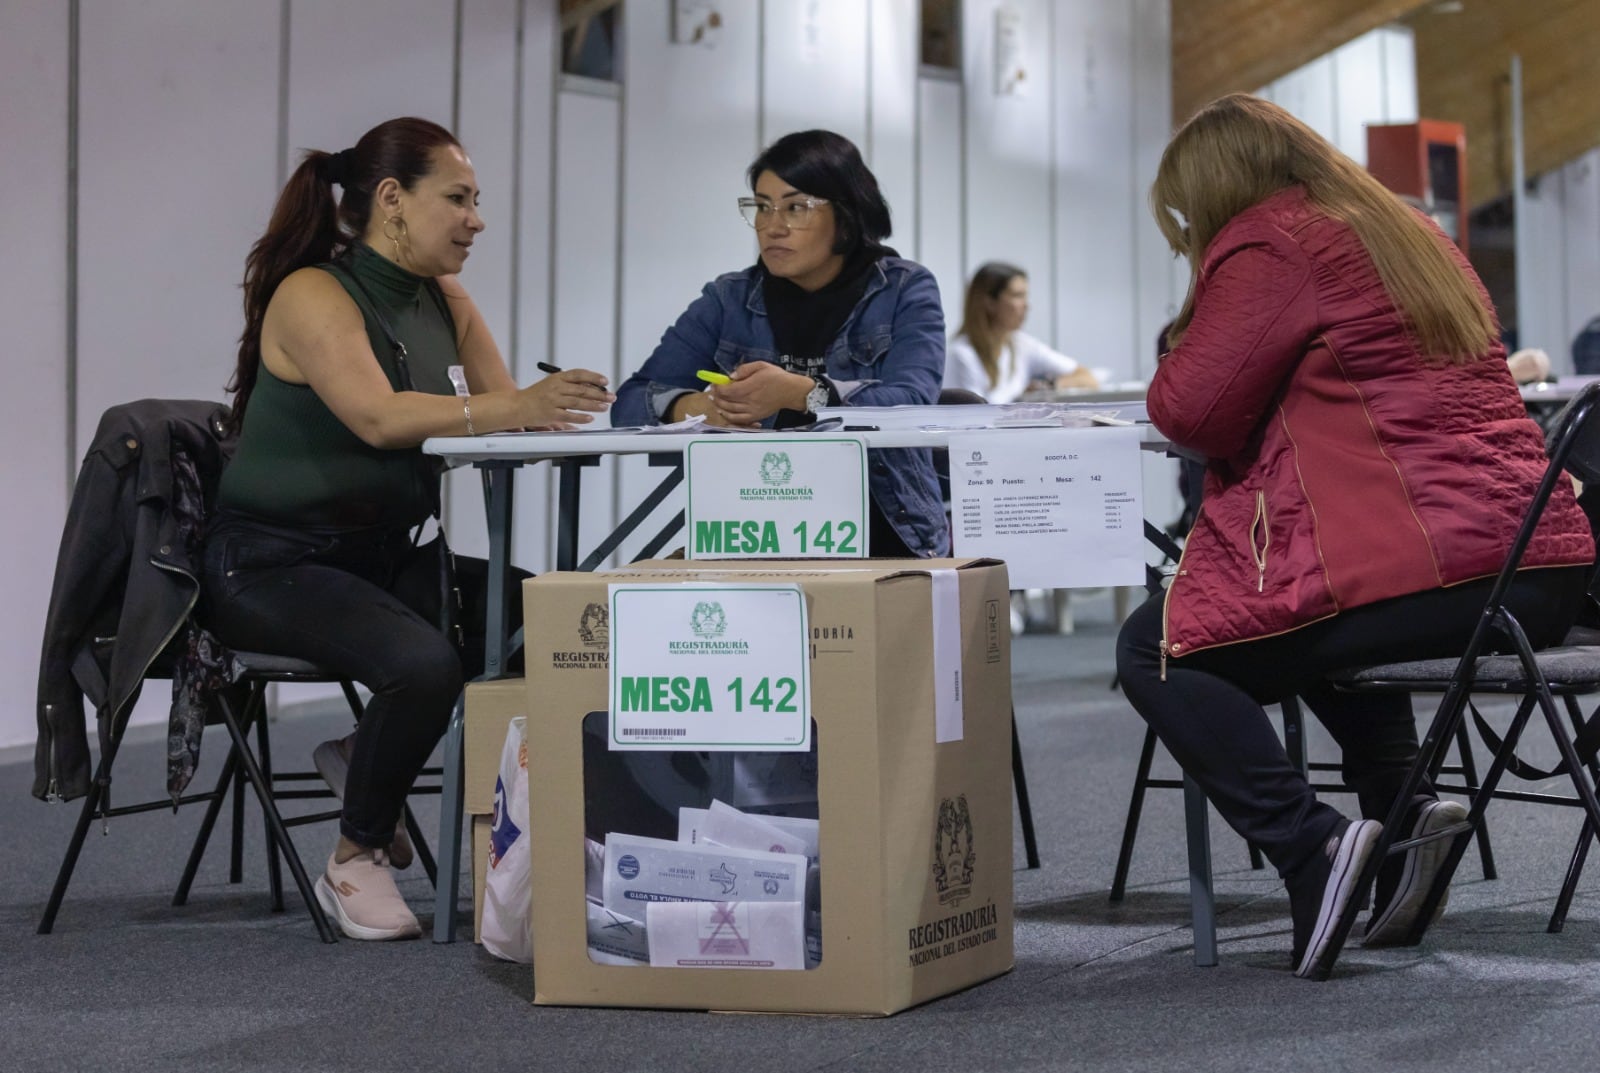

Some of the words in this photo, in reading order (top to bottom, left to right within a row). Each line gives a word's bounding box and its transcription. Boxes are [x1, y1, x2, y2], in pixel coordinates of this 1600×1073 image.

[740, 485, 813, 495] REGISTRADURÍA
[696, 520, 780, 553] MESA
[793, 520, 857, 553] 142
[669, 638, 749, 649] REGISTRADURÍA
[809, 625, 853, 640] DURÍA
[621, 676, 713, 712] MESA
[727, 677, 797, 712] 142
[909, 897, 997, 951] REGISTRADURÍA
[909, 946, 942, 967] NACIONAL
[943, 942, 956, 957] DEL
[957, 934, 981, 952] ESTADO
[982, 928, 997, 944] CIVIL
